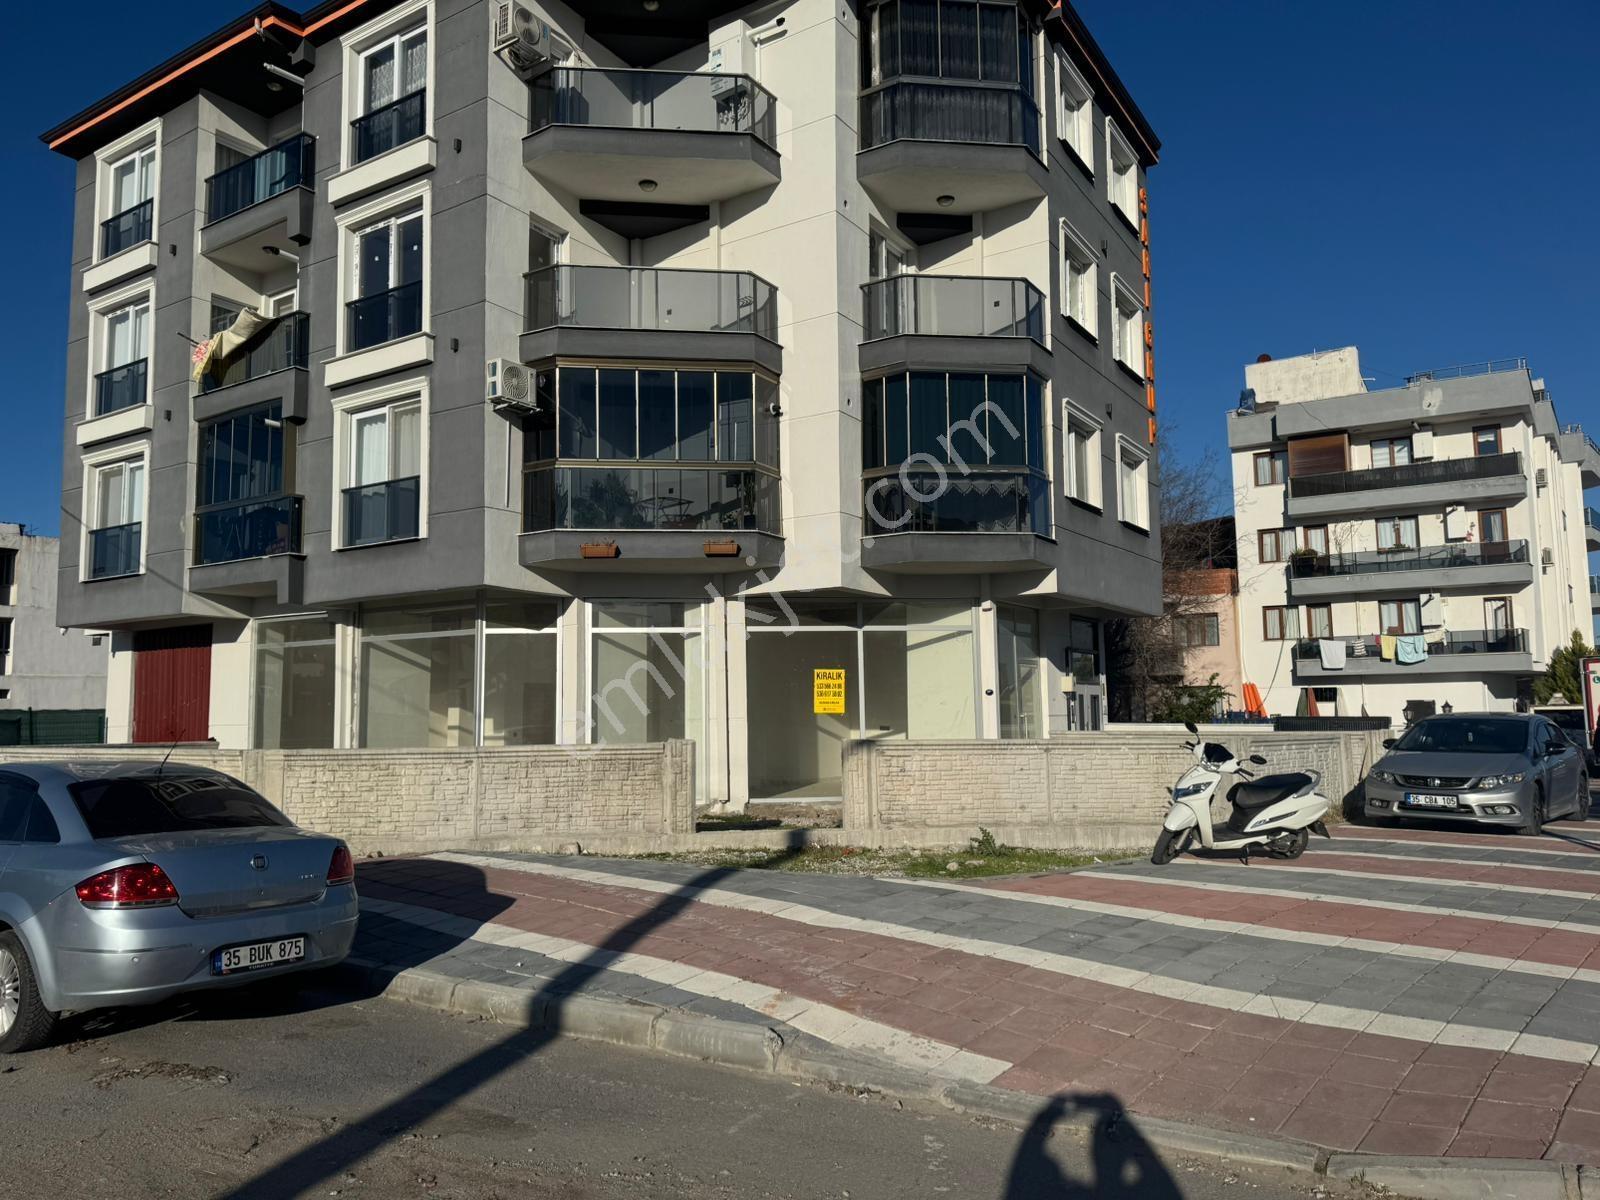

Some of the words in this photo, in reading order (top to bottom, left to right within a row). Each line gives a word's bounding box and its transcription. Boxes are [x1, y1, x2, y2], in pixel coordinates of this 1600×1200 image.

[1411, 794, 1420, 803] 35
[1442, 797, 1456, 805] 105
[224, 949, 241, 967] 35
[249, 943, 273, 963] BUK
[279, 940, 302, 958] 875
